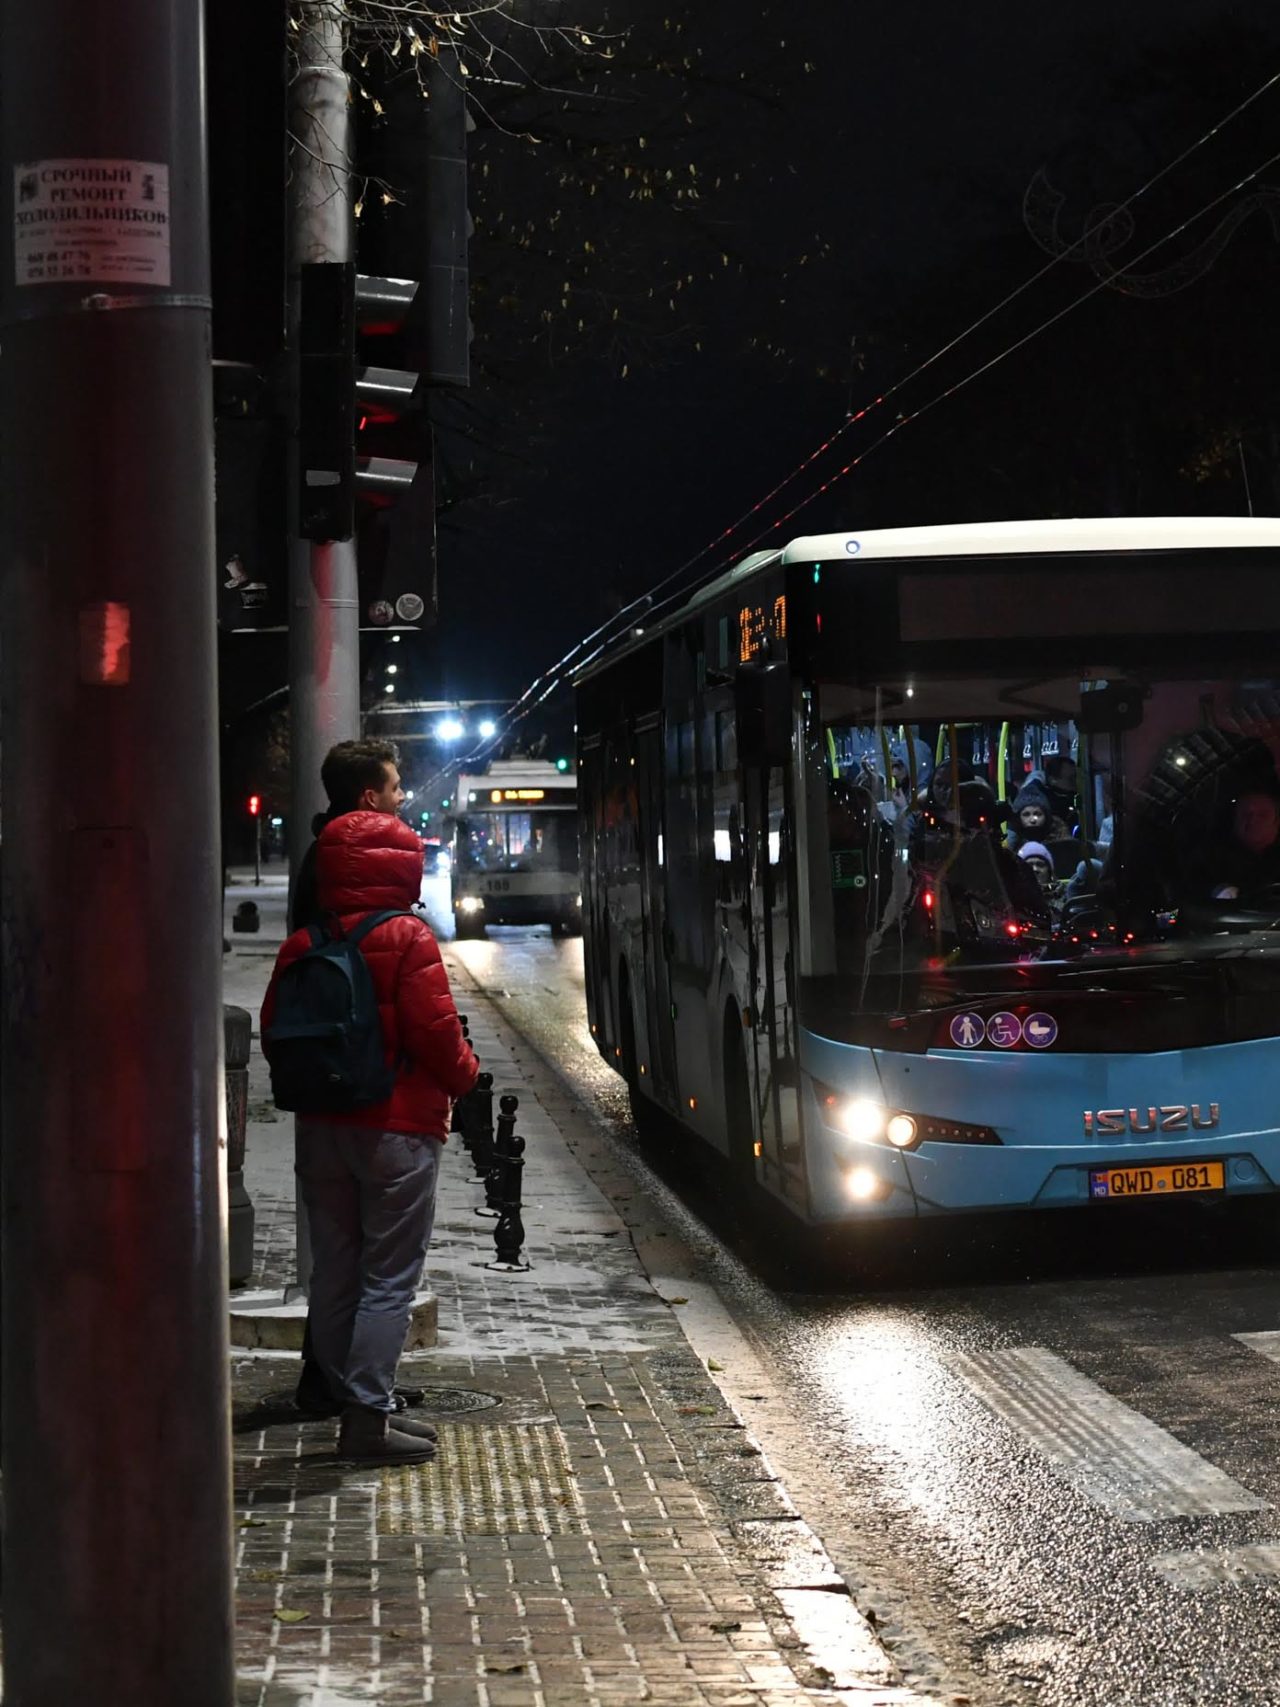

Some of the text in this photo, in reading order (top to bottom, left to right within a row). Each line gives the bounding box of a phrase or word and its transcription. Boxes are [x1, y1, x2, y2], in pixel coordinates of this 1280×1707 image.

[41, 168, 132, 183] СРОЧНЫЙ
[51, 187, 127, 202] РЕМОНТ
[15, 206, 166, 225] ХОЛОДИЛЬНИКОВ
[1084, 1103, 1219, 1136] ISUZU
[1111, 1166, 1211, 1194] QWD 081
[1094, 1186, 1106, 1195] MD
